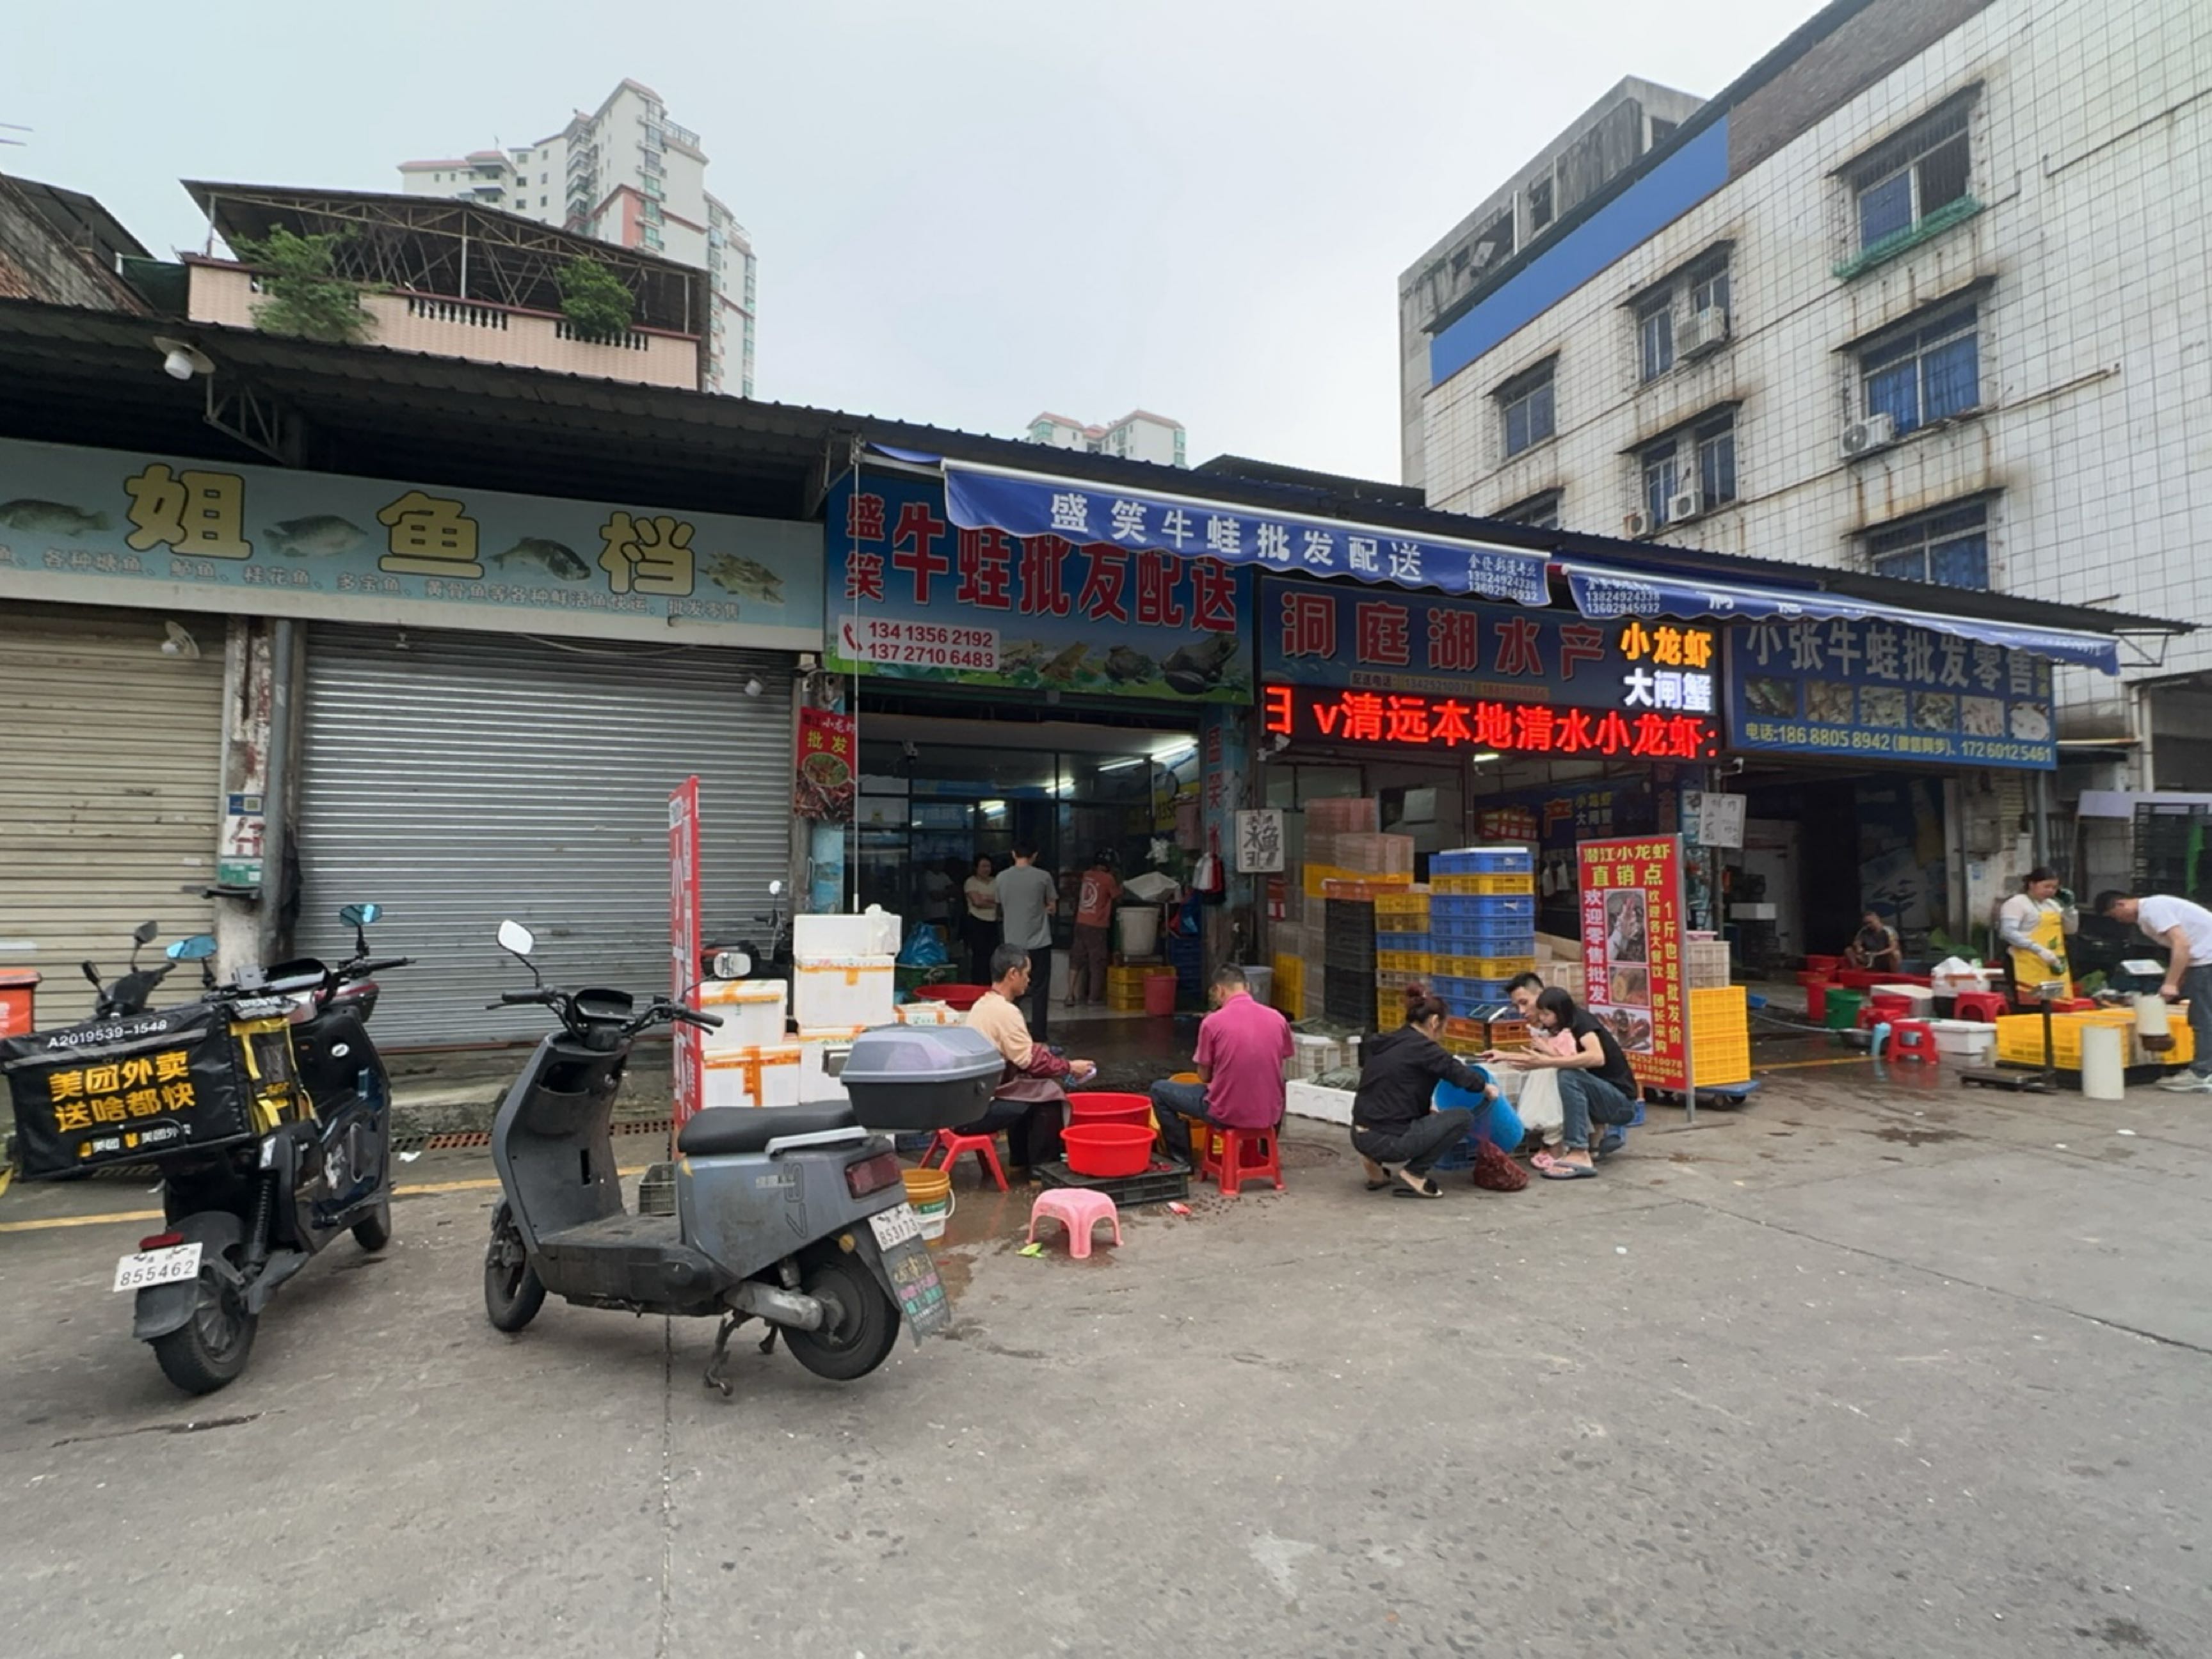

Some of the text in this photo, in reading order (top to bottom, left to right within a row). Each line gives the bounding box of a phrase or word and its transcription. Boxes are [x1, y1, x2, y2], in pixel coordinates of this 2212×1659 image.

[125, 462, 695, 596] 姐鱼档
[846, 493, 885, 602] 盛笑
[1050, 493, 1423, 582] 盛笑牛蛙批发配送
[894, 502, 1238, 634] 牛蛙批发配送
[868, 621, 993, 648] 134 1356 2192
[868, 642, 994, 668] 137 2710 6483
[1281, 593, 1606, 680] 洞庭湖水产
[1620, 622, 1713, 668] 小龙虾
[1746, 619, 2035, 696] 小张牛蛙批发零售
[1624, 669, 1712, 712] 大闸蟹
[807, 729, 847, 755] 批发
[1809, 728, 1849, 748] 8805
[1852, 732, 1889, 751] 8942
[1962, 740, 1984, 757] 172
[1986, 742, 2020, 760] 6012
[1583, 843, 1672, 863] 潜江小龙虾
[1591, 863, 1664, 886] 直销点
[1584, 888, 1607, 1004] 欢迎零售批发
[1663, 901, 1682, 1045] 1斤也是批发价
[47, 1020, 167, 1049] A2019539-1548
[49, 1050, 189, 1102] 美团外卖
[54, 1082, 195, 1134] 送啥都快
[120, 1260, 195, 1286] 855462
